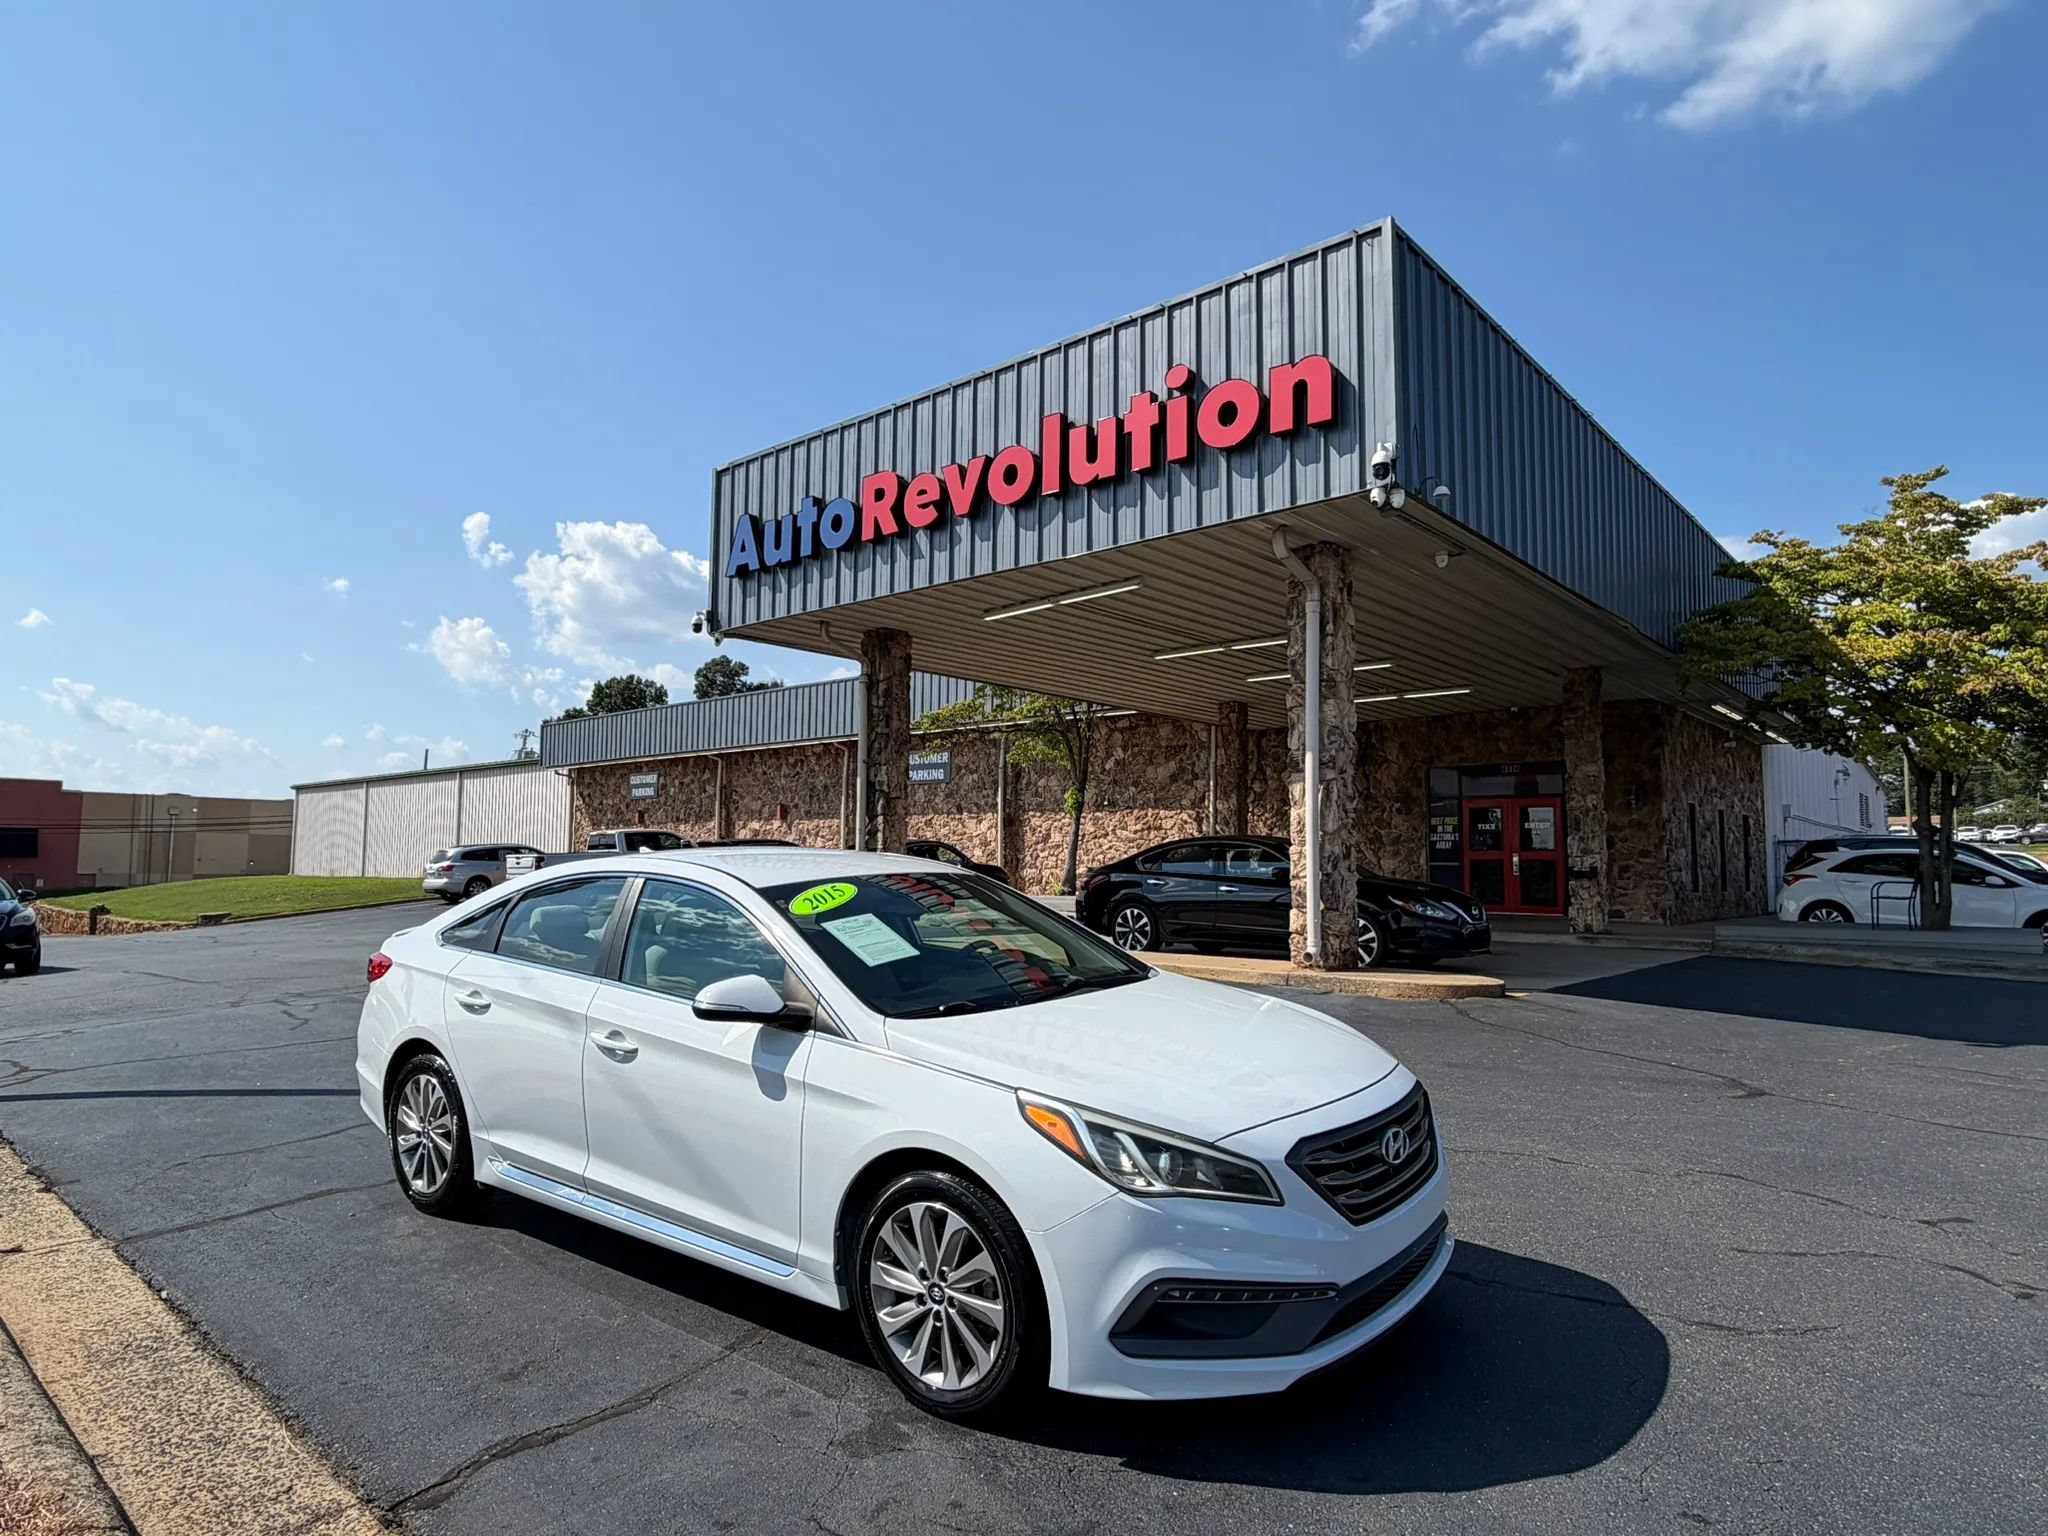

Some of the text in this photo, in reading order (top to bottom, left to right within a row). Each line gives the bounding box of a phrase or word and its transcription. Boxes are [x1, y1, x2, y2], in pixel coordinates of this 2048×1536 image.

[908, 752, 949, 765] USTOMER
[630, 774, 658, 784] CUSTOMER
[631, 786, 655, 797] PARKING
[803, 885, 846, 911] 2015
